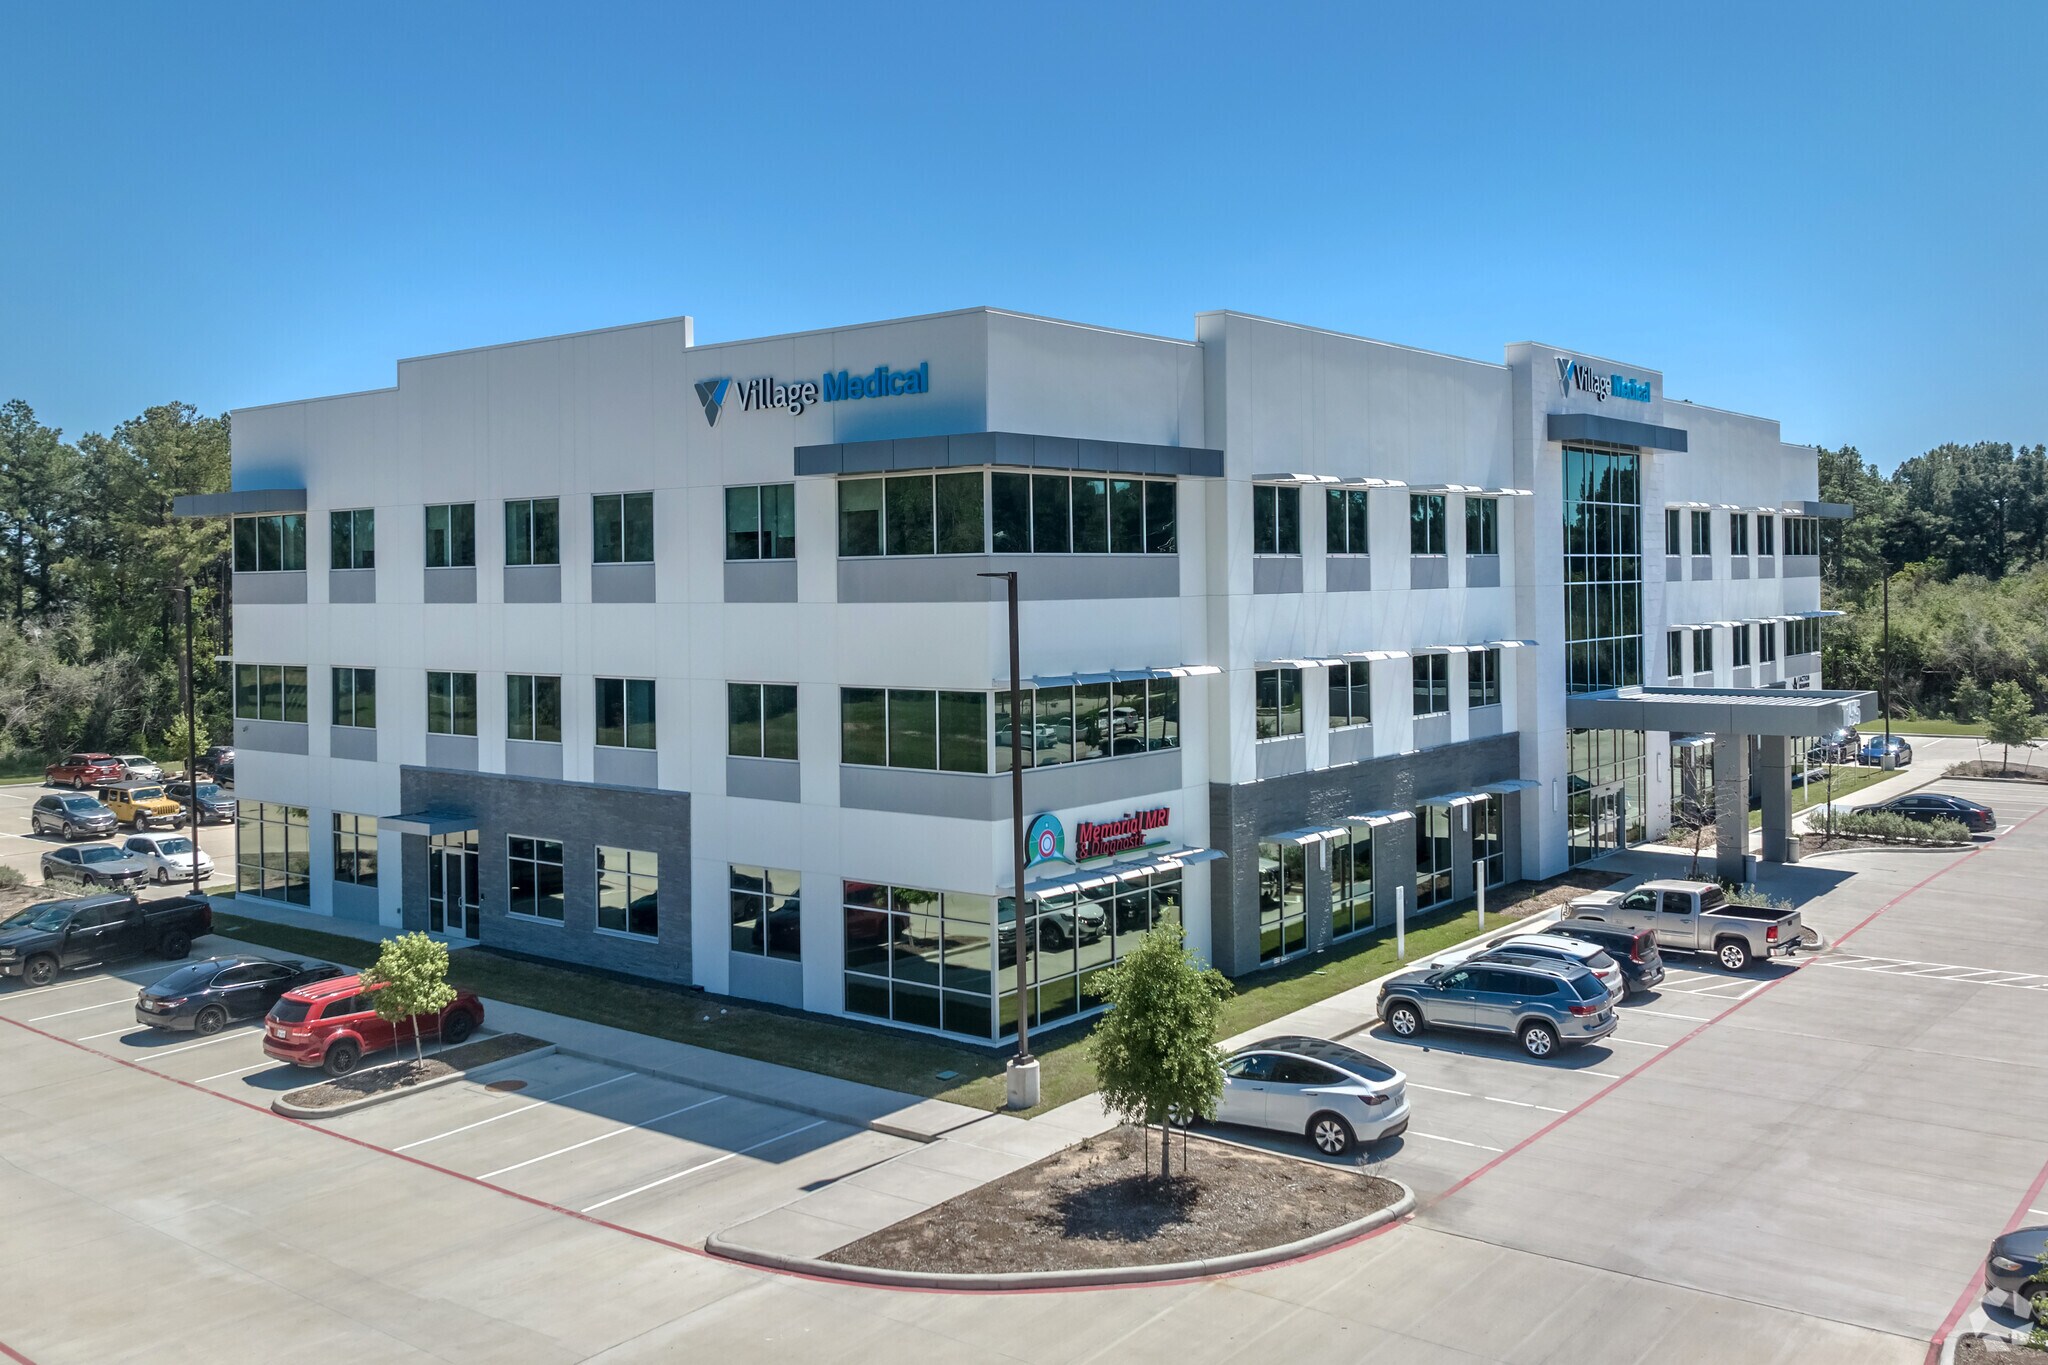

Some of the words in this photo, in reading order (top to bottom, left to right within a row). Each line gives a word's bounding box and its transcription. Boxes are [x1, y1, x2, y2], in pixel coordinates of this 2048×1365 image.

[734, 377, 817, 416] Village
[823, 362, 928, 402] Medical
[1574, 365, 1611, 402] Village
[1611, 374, 1650, 403] Medical
[1077, 811, 1143, 843] Memorial
[1143, 807, 1169, 829] MRI
[1076, 841, 1088, 858] &
